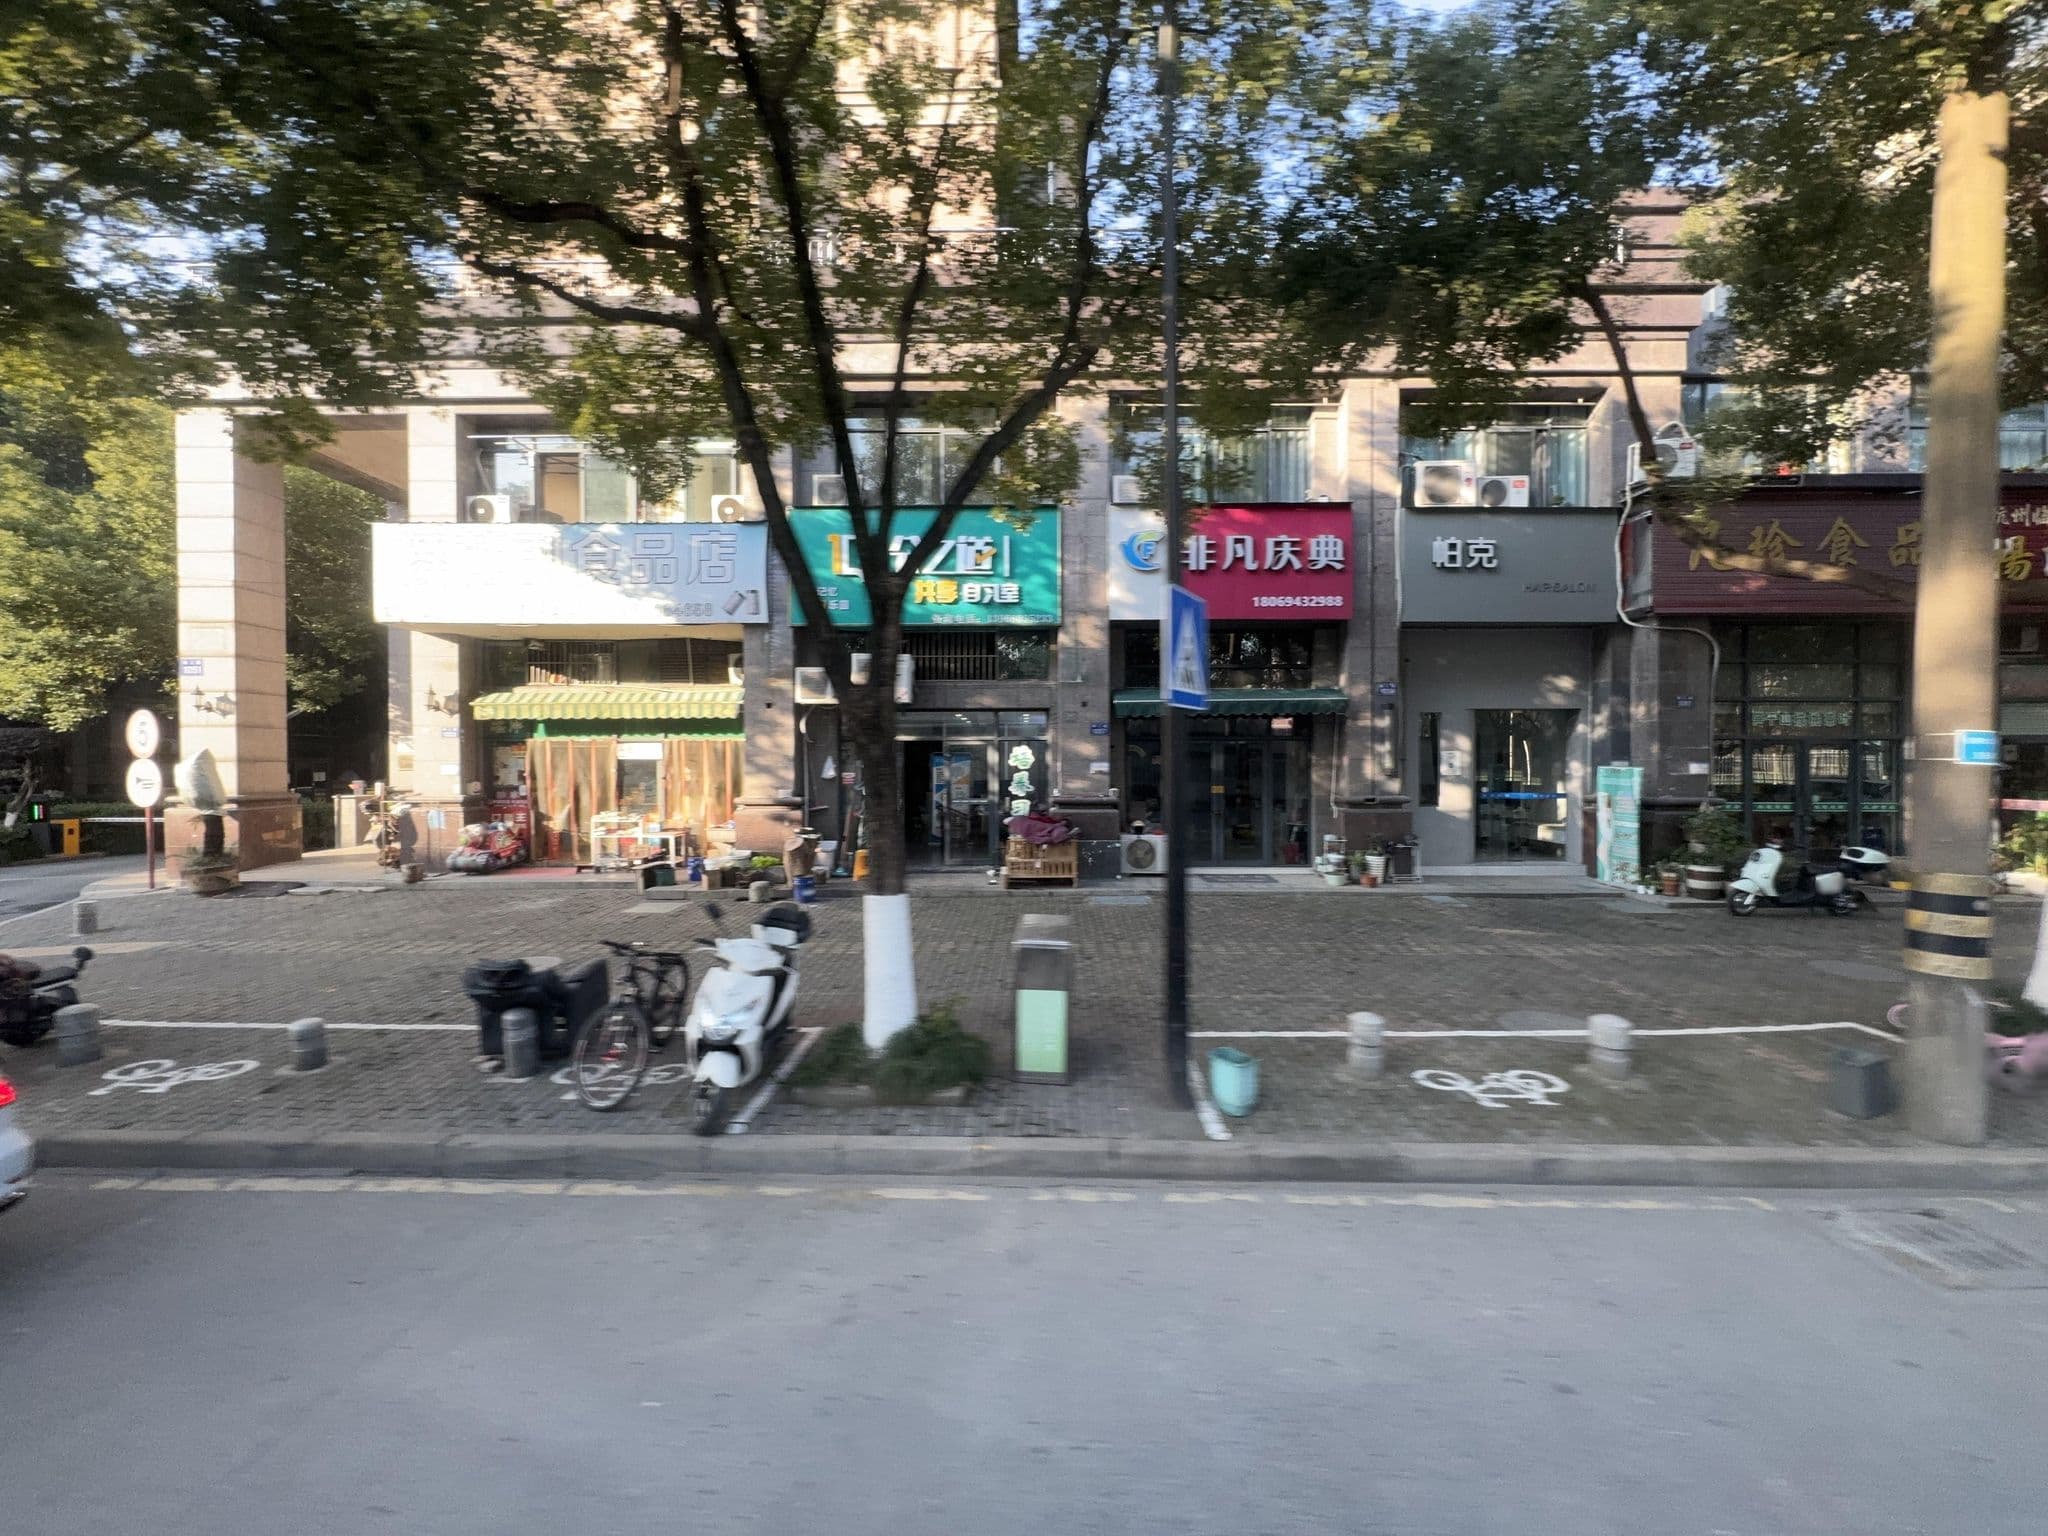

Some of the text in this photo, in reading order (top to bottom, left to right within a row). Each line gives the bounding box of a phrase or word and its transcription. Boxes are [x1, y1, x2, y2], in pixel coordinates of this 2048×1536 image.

[1180, 534, 1346, 571] 非凡庆典
[1432, 536, 1498, 568] 帕克
